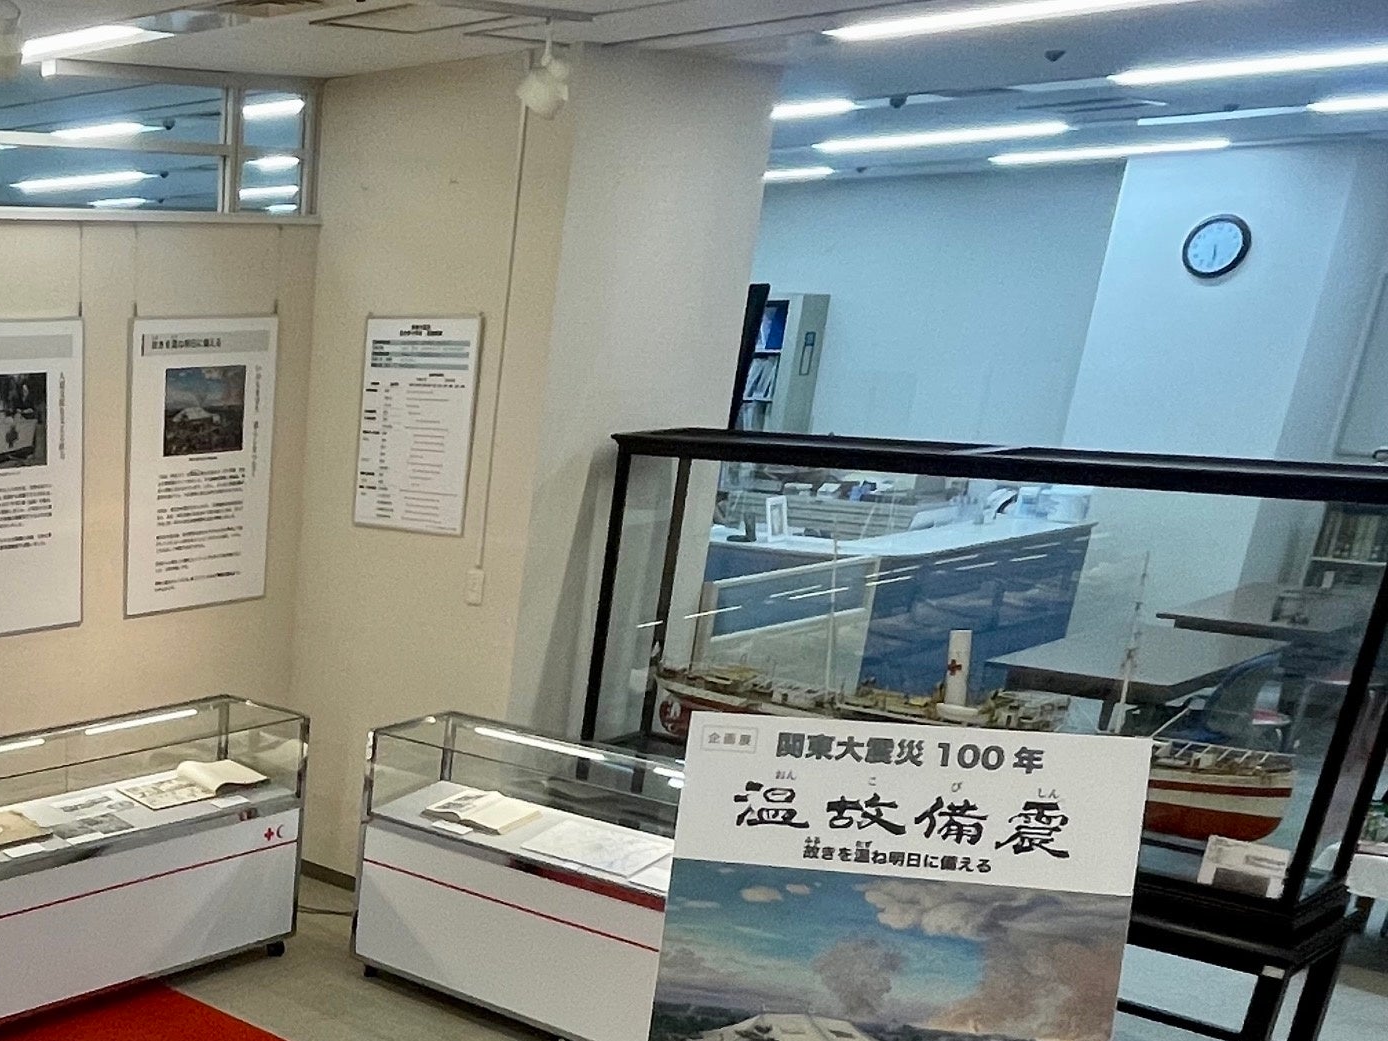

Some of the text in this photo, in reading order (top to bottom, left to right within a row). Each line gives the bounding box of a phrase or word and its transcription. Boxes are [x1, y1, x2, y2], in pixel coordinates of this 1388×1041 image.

[708, 732, 752, 745] 企画展
[734, 780, 1070, 859] 温故備震
[802, 843, 992, 873] 故きを温ね明日に備える
